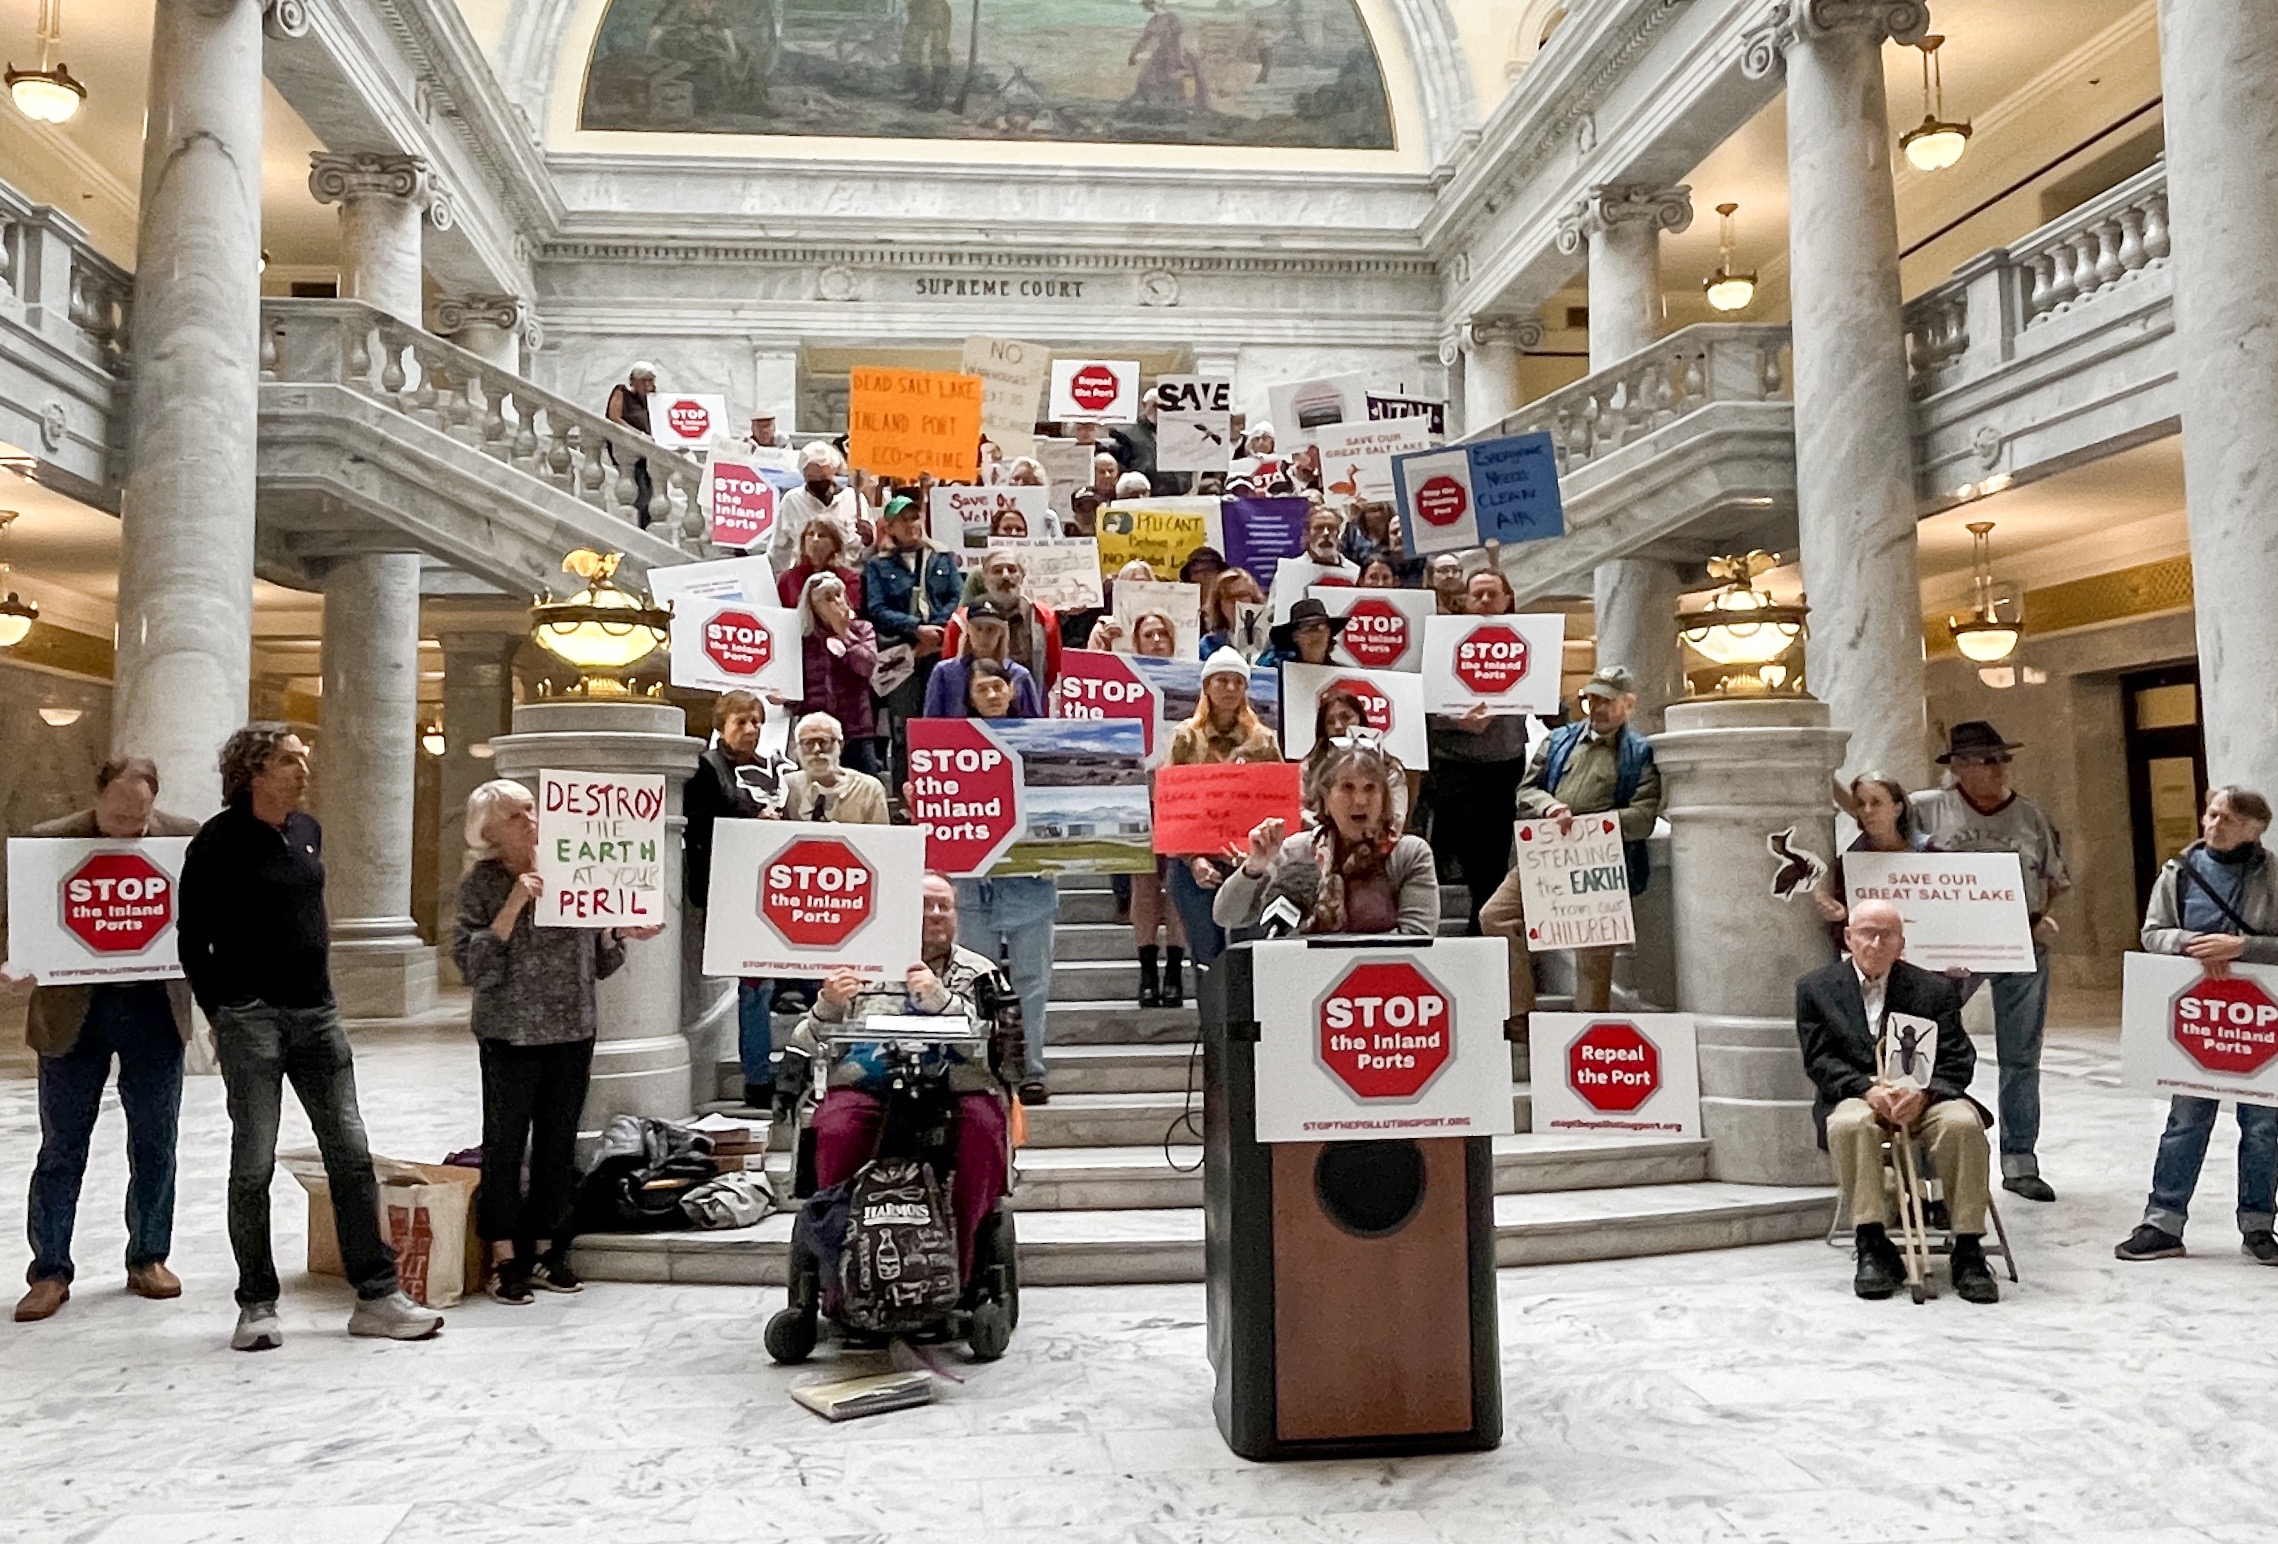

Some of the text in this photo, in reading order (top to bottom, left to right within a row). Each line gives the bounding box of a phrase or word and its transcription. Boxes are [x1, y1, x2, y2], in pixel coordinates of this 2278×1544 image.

[916, 278, 1084, 298] SUPREME COURT
[990, 341, 1024, 365] NO
[854, 375, 893, 392] DEAD
[898, 377, 931, 396] SALT
[938, 380, 978, 400] LAKE
[1157, 382, 1230, 412] SAVE
[670, 409, 707, 420] STOP
[854, 411, 957, 436] INLAND PORT
[871, 446, 964, 469] ECO-CRIME
[1325, 447, 1361, 459] GREAT
[1365, 445, 1391, 455] SALT
[714, 477, 768, 496] STOP
[715, 492, 742, 506] the
[949, 492, 989, 510] Save
[1477, 488, 1536, 510] CLEAN
[715, 503, 766, 520] Inland
[1497, 511, 1537, 530] AIR
[715, 515, 758, 532] Ports
[1345, 615, 1404, 633] STOP
[707, 624, 769, 645] STOP
[709, 639, 767, 657] the Inland
[722, 650, 754, 664] Ports
[1460, 642, 1526, 660] STOP
[1461, 660, 1521, 671] the Inland
[1474, 670, 1507, 680] Ports
[1062, 676, 1146, 704] STOP
[1063, 701, 1105, 719] the
[1357, 695, 1388, 713] OP
[910, 748, 1003, 773] STOP
[914, 776, 960, 796] the
[546, 781, 664, 823] DESTROY
[916, 797, 1001, 818] Inland
[581, 820, 626, 839] THE
[918, 822, 991, 841] Ports
[556, 838, 656, 864] EARTH
[1526, 842, 1621, 869] STEALING
[572, 865, 660, 891] AT YOUR
[768, 864, 869, 892] STOP
[1536, 865, 1627, 897] the EARTH
[1887, 873, 1978, 886] SAVE OUR
[68, 877, 168, 902] STOP
[1855, 887, 2015, 902] GREAT SALT LAKE
[72, 903, 165, 918] the Inland
[559, 887, 648, 918] PERIL
[770, 892, 864, 910] the Inland
[1550, 900, 1592, 917] from
[94, 919, 144, 932] Ports
[791, 909, 841, 924] Ports
[1538, 915, 1631, 946] CHILDREN
[1325, 994, 1445, 1029] STOP
[2178, 996, 2278, 1027] STOP
[1330, 1031, 1441, 1051] the Inland
[2182, 1023, 2276, 1044] the Inland
[1581, 1044, 1645, 1065] Repeal
[2203, 1038, 2253, 1056] Ports
[1357, 1053, 1416, 1070] Ports
[1576, 1067, 1652, 1086] the Port
